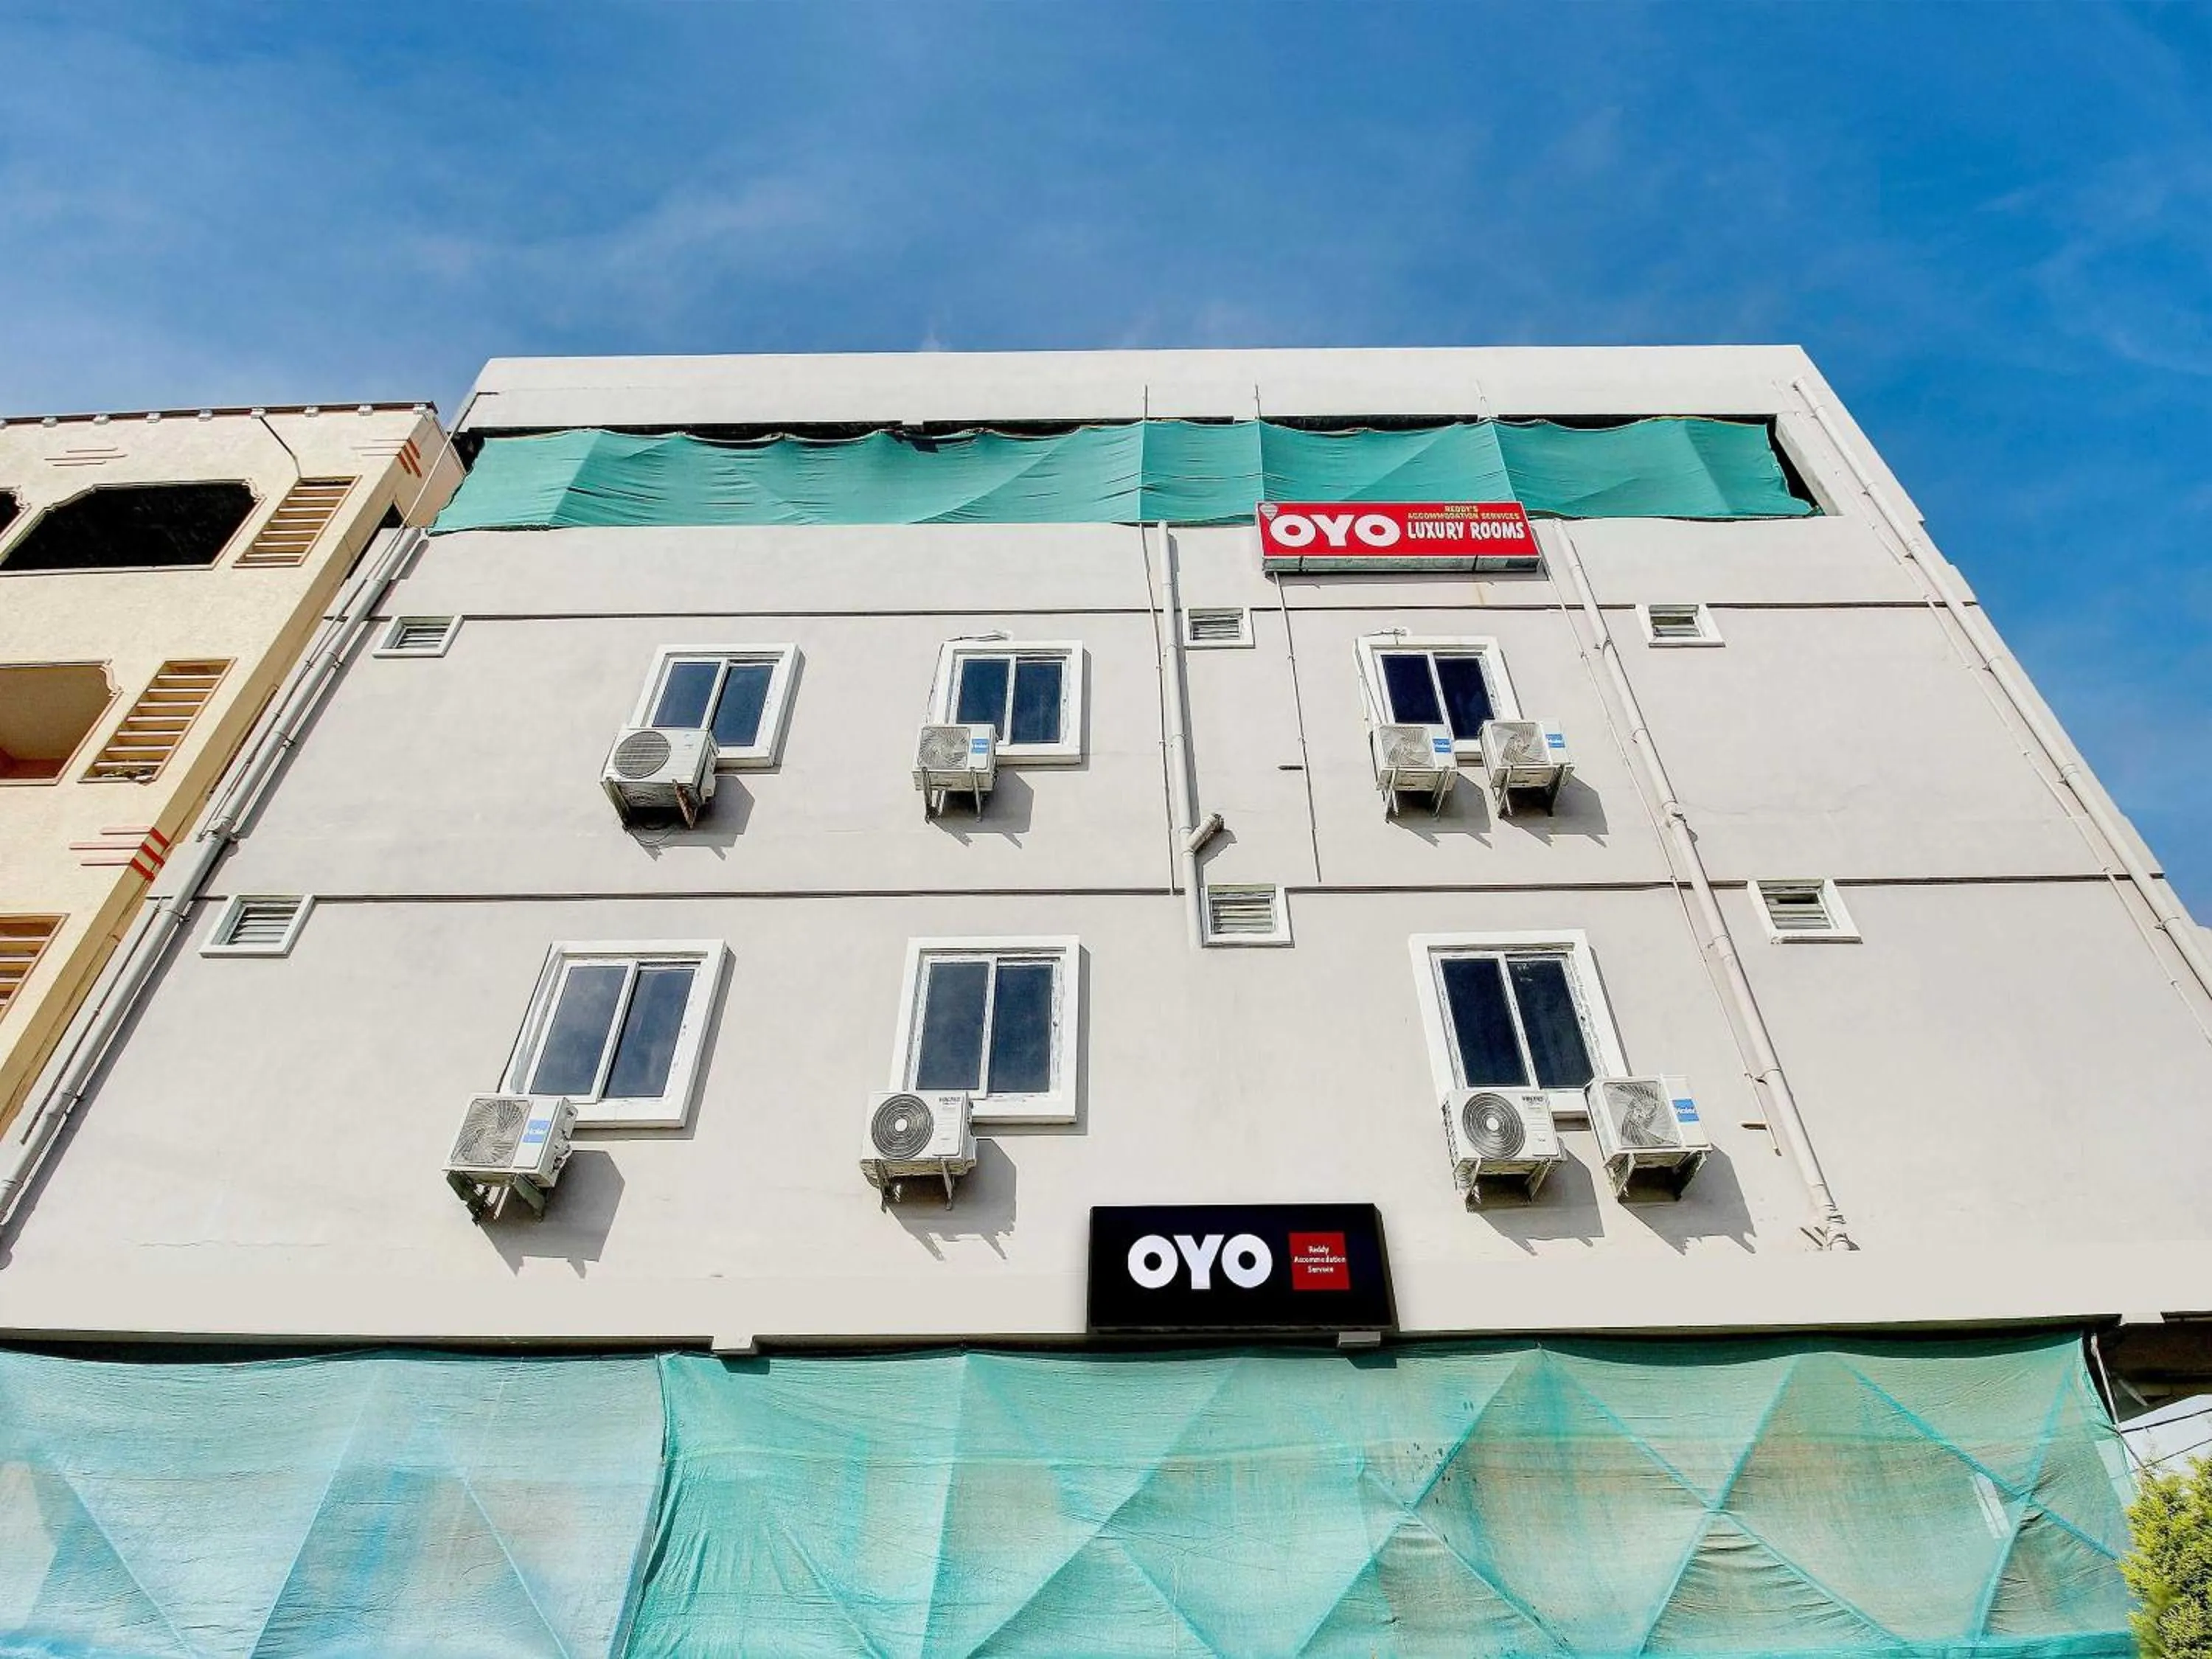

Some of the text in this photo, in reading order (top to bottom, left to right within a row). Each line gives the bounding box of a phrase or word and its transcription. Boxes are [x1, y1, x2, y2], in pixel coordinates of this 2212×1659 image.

[1270, 514, 1401, 547] OYO
[1407, 521, 1526, 540] LUXURY ROOMS
[1127, 1234, 1273, 1290] OYO
[1308, 1245, 1329, 1255] Reddy
